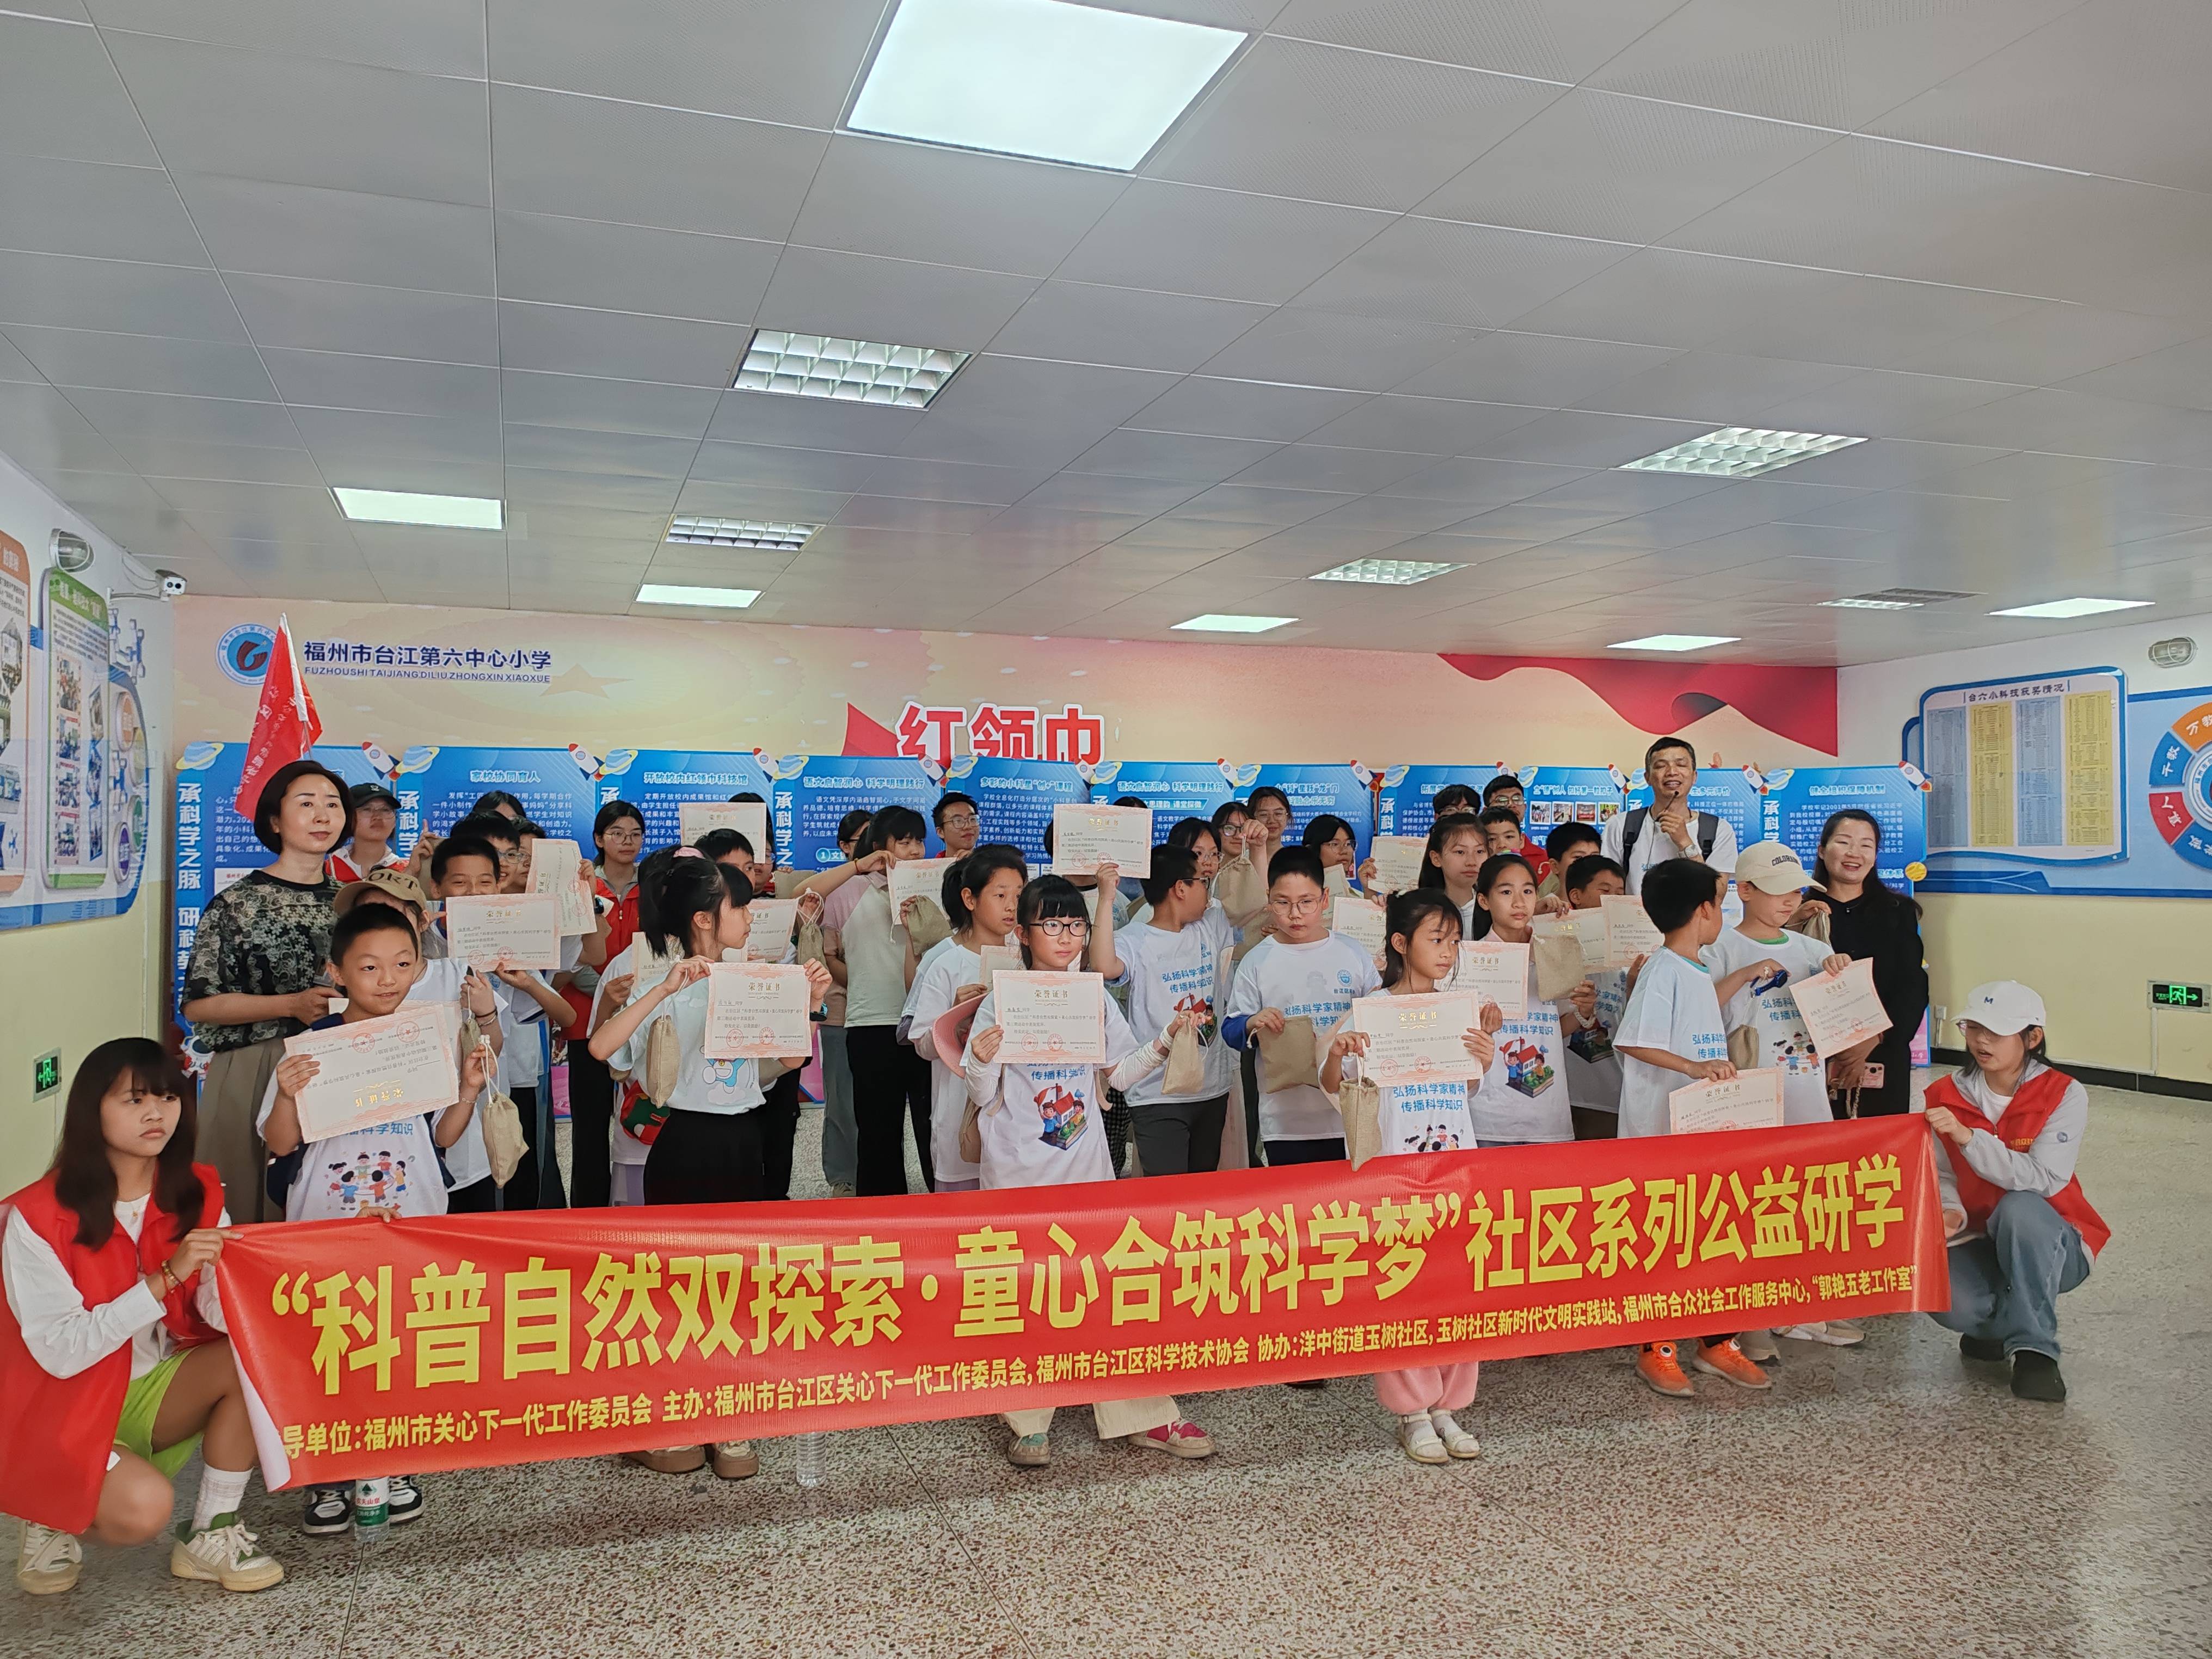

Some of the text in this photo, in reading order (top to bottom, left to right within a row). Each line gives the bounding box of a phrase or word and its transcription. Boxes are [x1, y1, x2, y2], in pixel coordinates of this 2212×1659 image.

[304, 641, 551, 669] 福州市台江第六中心小学
[506, 674, 550, 683] XIAOXUE
[1968, 683, 2065, 703] 台六小科技获奖情况
[897, 703, 1103, 764] 红领巾
[470, 770, 541, 784] 家校协同育人
[643, 772, 749, 785] 开放校内红领巾科技馆
[803, 776, 925, 789] 语文启智润心 科学明理践行
[1117, 781, 1224, 792] 语文启智润心 科学明理践行
[398, 790, 420, 857] 承科学
[1380, 797, 1396, 836] 承科
[1763, 800, 1781, 842] 承科学
[775, 791, 793, 865] 承科学之
[177, 783, 202, 889] 承科学之脉
[748, 982, 780, 992] 荣誉证书
[1034, 990, 1068, 998] 荣誉证书
[1762, 997, 1796, 1009] 弘扬科
[1983, 996, 1994, 1004] M
[1284, 1001, 1351, 1016] 弘扬科学家精神
[1314, 1016, 1341, 1027] 学知
[1398, 1010, 1438, 1022] 荣誉证书
[1527, 1011, 1559, 1023] 学家精神
[1500, 1024, 1554, 1036] 传播科学知识
[1393, 1082, 1465, 1098] 弘扬科学家精神
[1401, 1098, 1463, 1113] 传播科学知识
[272, 1152, 1904, 1396] “科普自然双探索·童心合筑科学梦”社区系列公益研学
